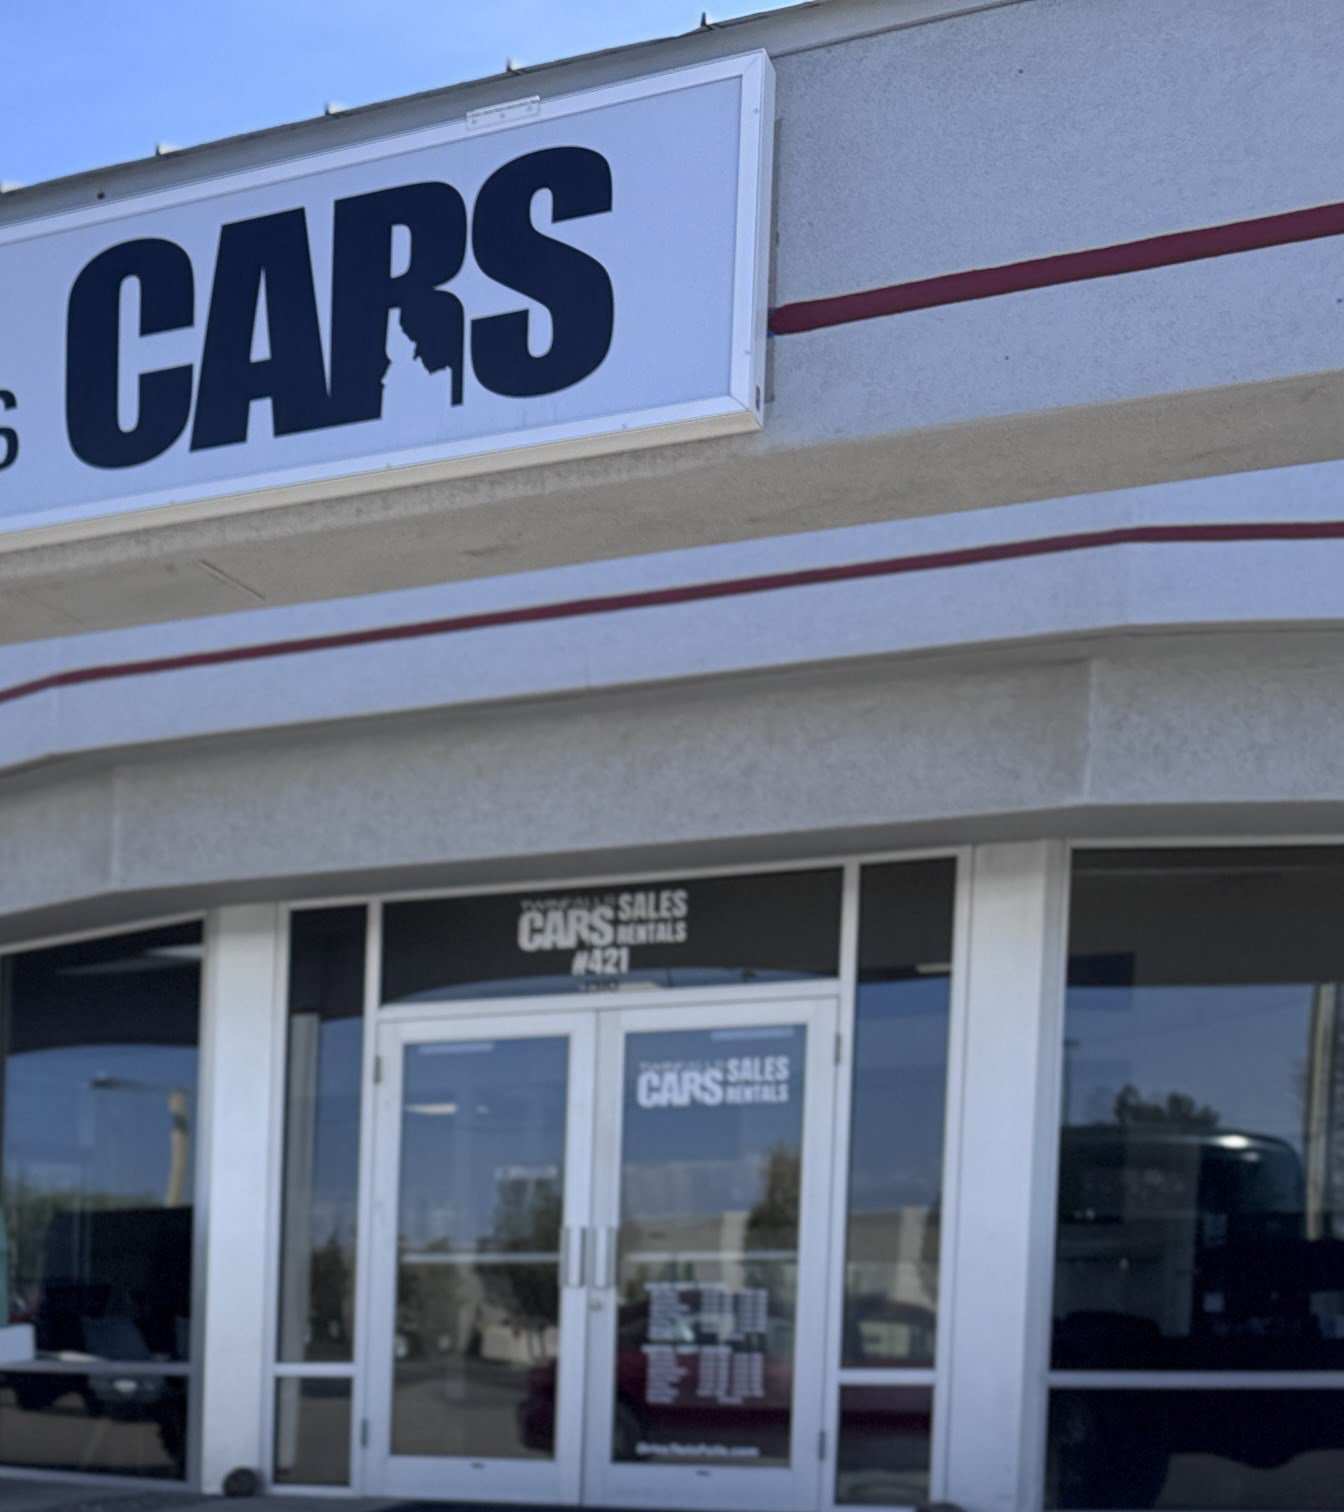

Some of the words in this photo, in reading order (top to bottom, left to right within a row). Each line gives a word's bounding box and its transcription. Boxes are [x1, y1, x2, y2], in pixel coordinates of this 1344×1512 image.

[66, 145, 615, 470] CARS
[618, 889, 688, 921] SALES
[518, 904, 615, 952] CARS
[571, 946, 630, 976] #421
[638, 1067, 724, 1108] CARS
[726, 1056, 790, 1083] SALES
